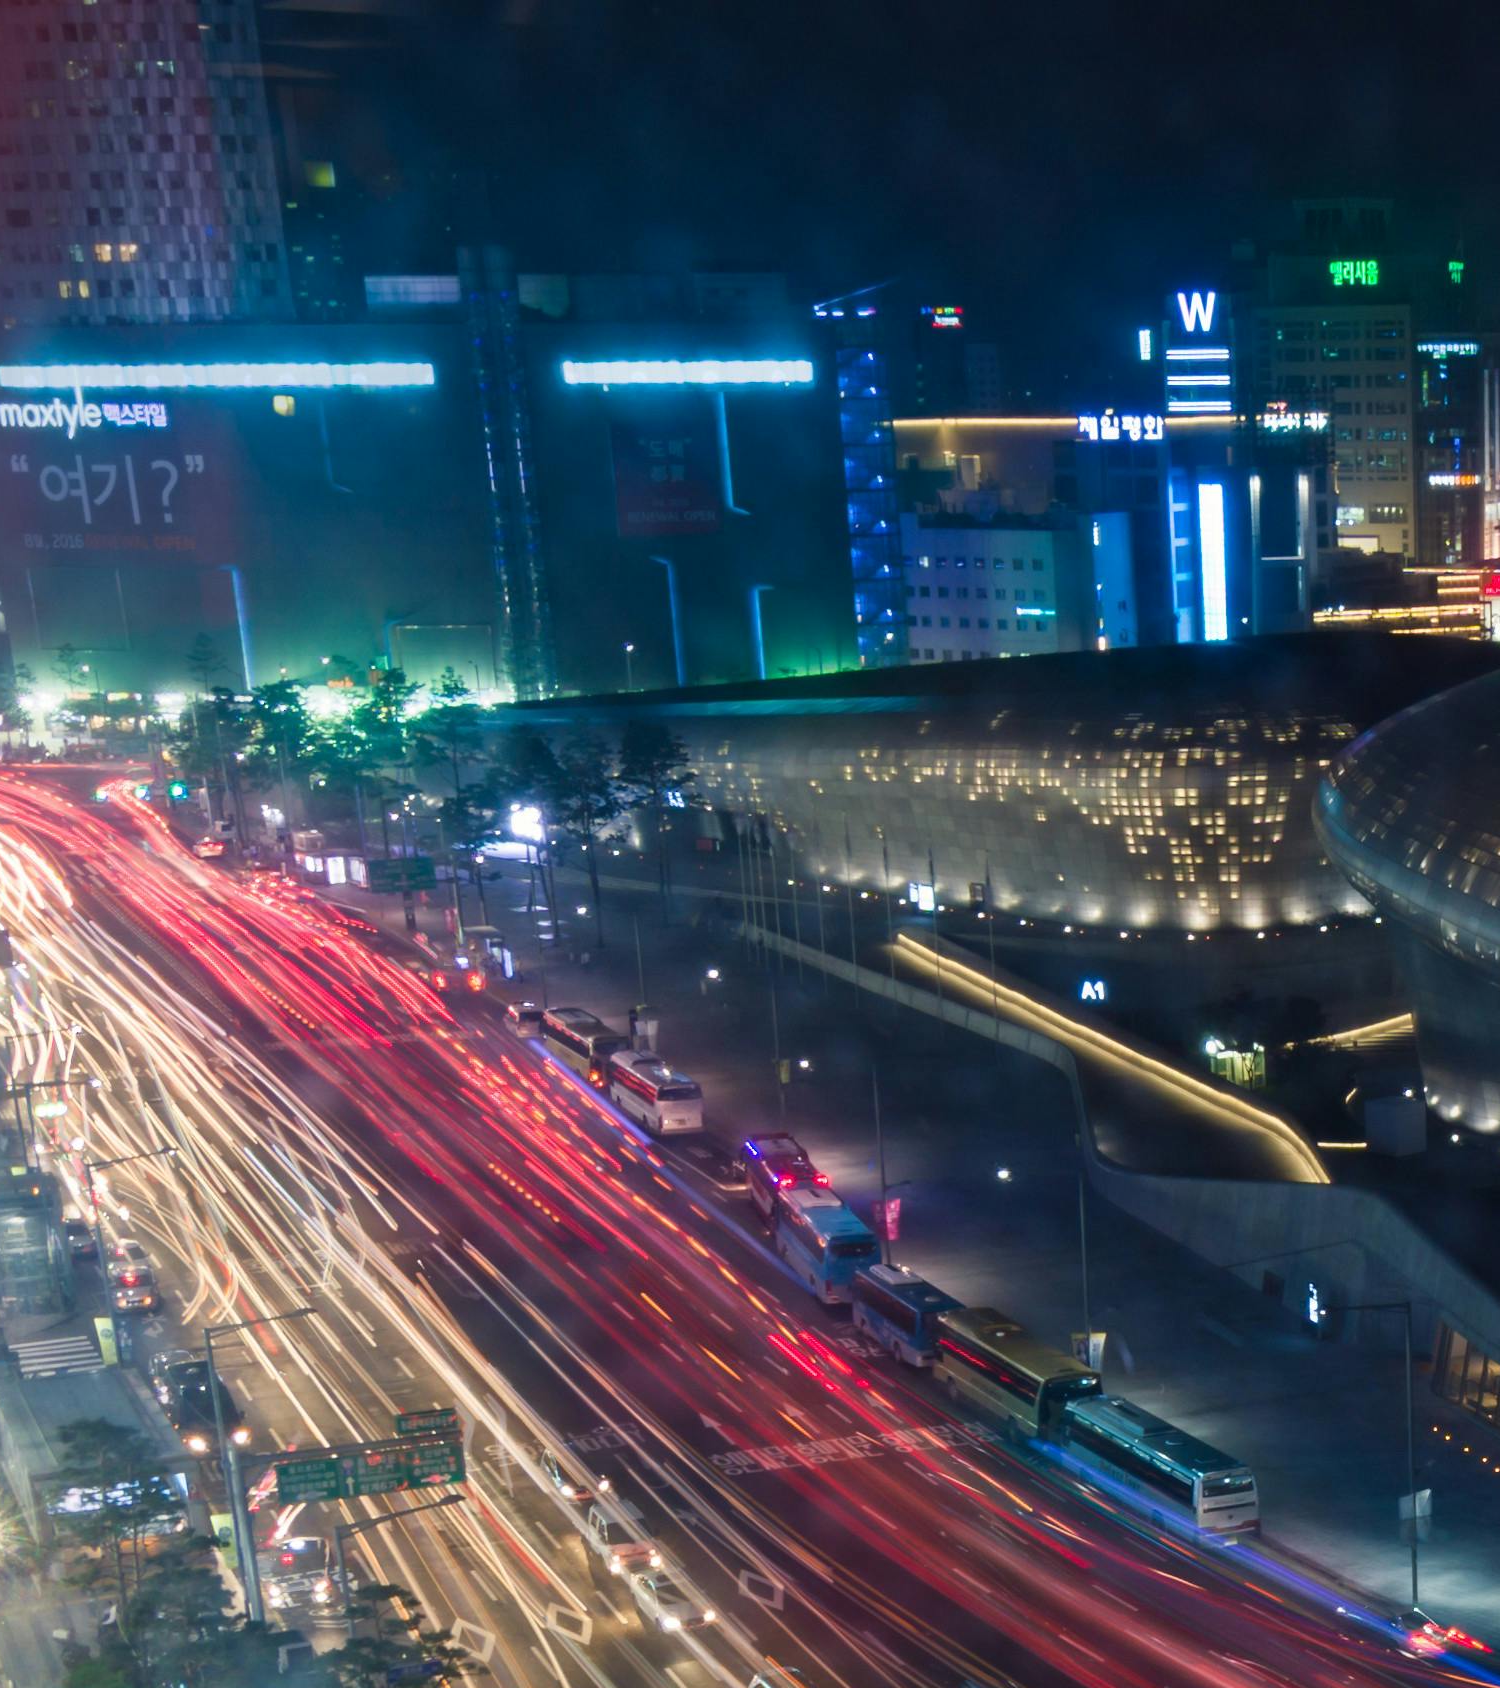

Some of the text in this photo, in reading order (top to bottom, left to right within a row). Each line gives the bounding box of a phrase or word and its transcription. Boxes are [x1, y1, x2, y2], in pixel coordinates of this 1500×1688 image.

[1177, 291, 1216, 332] W
[102, 402, 168, 428] 맥스타일
[1081, 981, 1105, 1000] A1
